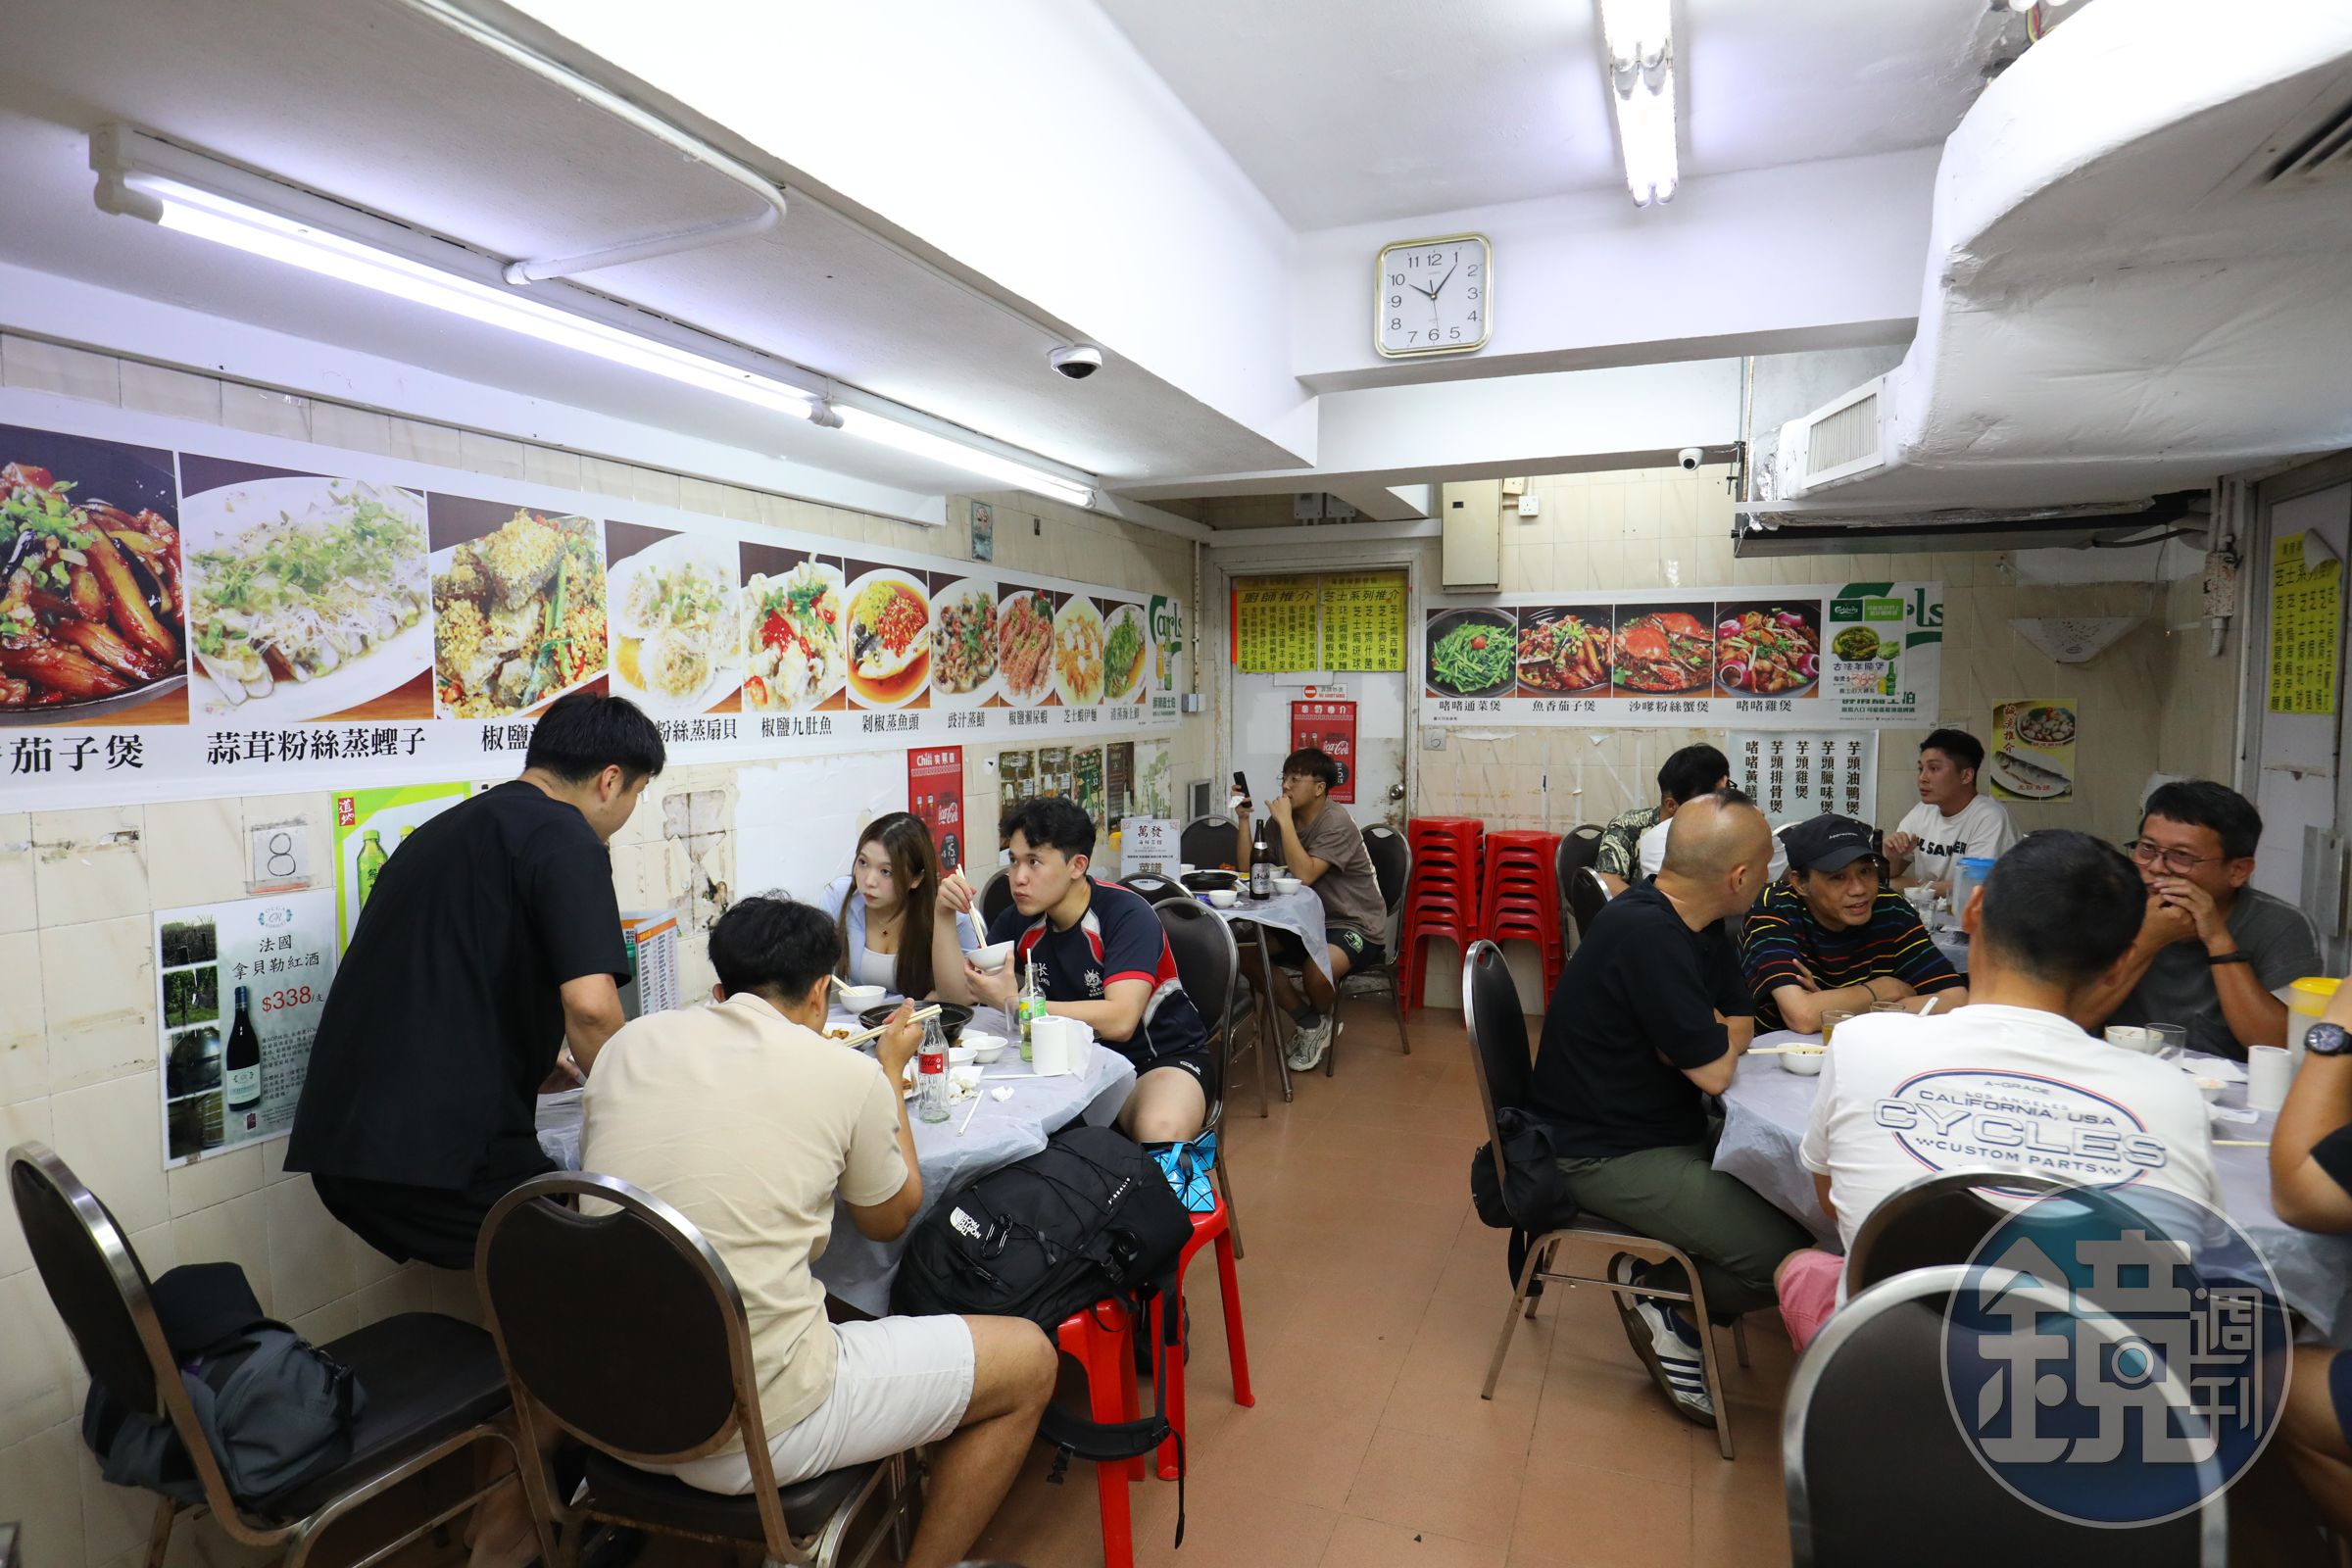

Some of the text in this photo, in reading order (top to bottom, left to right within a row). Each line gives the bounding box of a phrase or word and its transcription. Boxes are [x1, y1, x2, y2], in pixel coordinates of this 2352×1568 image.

[1408, 256, 1419, 269] 11
[1427, 253, 1442, 267] 12
[1467, 264, 1479, 277] 2
[1391, 273, 1405, 286] 10
[1391, 295, 1402, 308] 9
[1467, 287, 1479, 300] 3
[1467, 310, 1478, 321] 4
[1391, 318, 1401, 330] 8
[1407, 330, 1418, 343] 7
[1428, 328, 1440, 341] 6
[1449, 326, 1461, 339] 5
[1324, 589, 1399, 602] 芝士系列推介
[1439, 700, 1501, 712] 啫啫通菜煲
[1532, 700, 1596, 712] 魚香茄子煲
[1629, 700, 1709, 713] 沙嗲粉絲蟹煲
[1736, 699, 1792, 712] 啫啫雞煲
[761, 715, 832, 738] 椒鹽九肚魚
[481, 723, 537, 752] 椒鹽
[207, 727, 425, 765] 蒜茸粉絲蒸蟶子
[0, 734, 144, 775] 茄子煲
[1744, 740, 1759, 807] 啫啫黃鱔
[1770, 740, 1784, 813] 芋頭排骨煲
[1795, 740, 1809, 800] 芋頭雞煲
[1820, 740, 1835, 814] 芋頭臘味煲
[1845, 740, 1861, 815] 芋頭油鴨煲
[338, 798, 355, 825] 道地
[1138, 825, 1162, 838] 萬發
[268, 831, 296, 877] 8
[259, 934, 292, 953] 法國
[232, 952, 319, 980] 拿貝勒紅酒
[1984, 1080, 2052, 1096] A-GRADE
[1919, 1090, 2117, 1127] CALIFORNIA, USA
[1965, 1090, 2070, 1111] LOS ANGELES
[1874, 1098, 2167, 1168] CYCLES
[1936, 1140, 2098, 1173] CUSTOM PARTS
